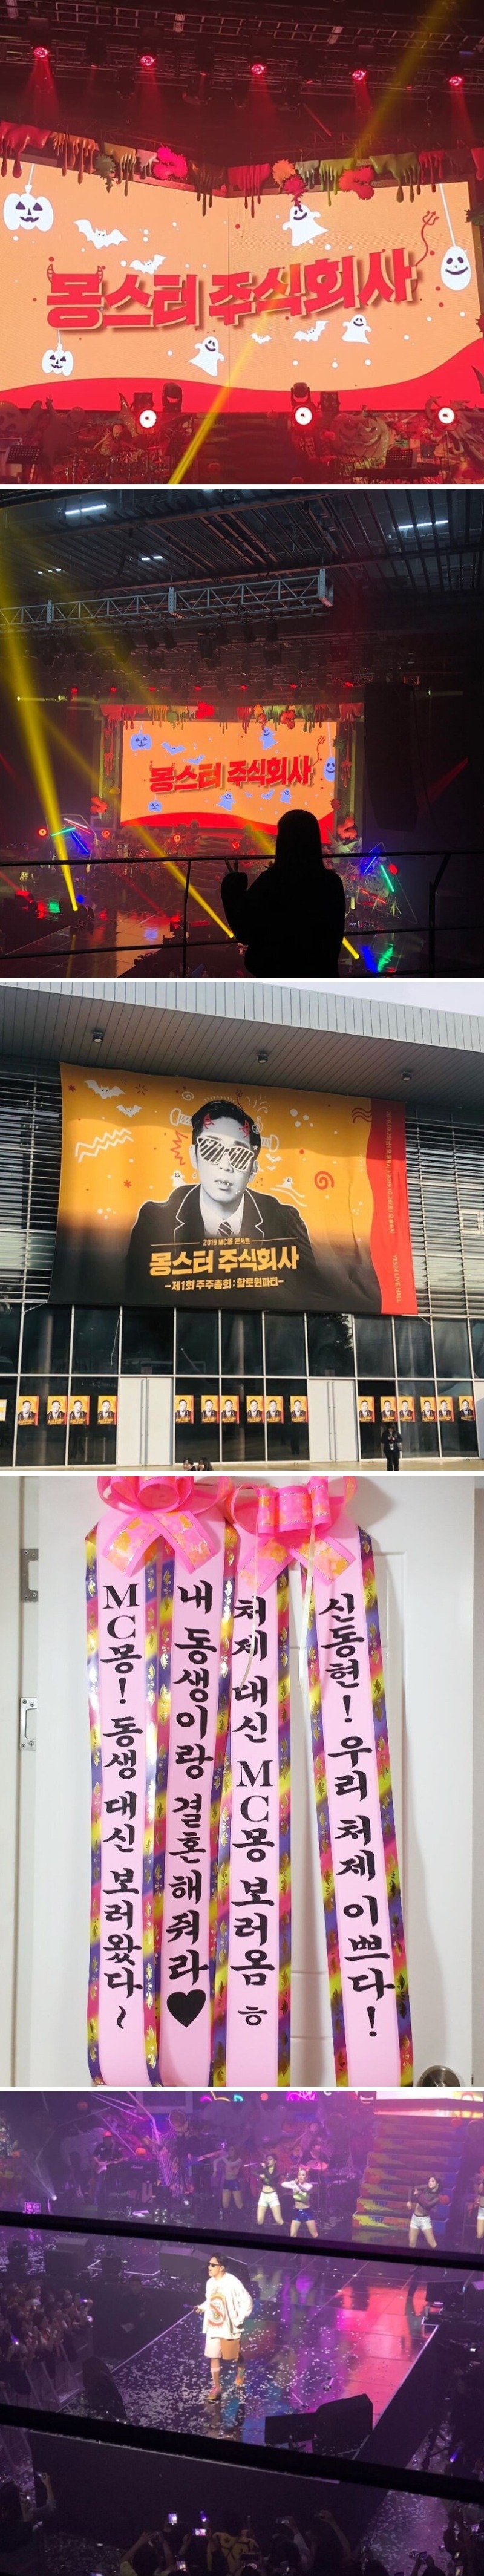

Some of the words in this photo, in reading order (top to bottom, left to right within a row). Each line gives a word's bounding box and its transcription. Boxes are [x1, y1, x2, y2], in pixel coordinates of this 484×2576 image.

[47, 270, 199, 329] 몽스터
[209, 248, 417, 325] 주식회사
[149, 763, 222, 793] 몽스터
[227, 755, 312, 787] 주식회사
[149, 1249, 213, 1277] 몽스터
[218, 1246, 299, 1273] 주식회사
[177, 1580, 213, 1615] 내
[232, 1595, 268, 1662] 처제
[100, 1583, 142, 1705] MC몽!
[318, 1592, 365, 1724] 신동현!
[173, 1627, 218, 1780] 동생이랑
[232, 1675, 269, 1744] 대신
[102, 1716, 143, 1780] 동생
[327, 1736, 373, 1802] 우리
[102, 1791, 137, 1854] 대신
[232, 1759, 275, 1863] MC몽
[335, 1814, 376, 1882] 처제
[230, 1877, 275, 1986] 보러옴
[343, 1895, 396, 2038] 이쁘다!
